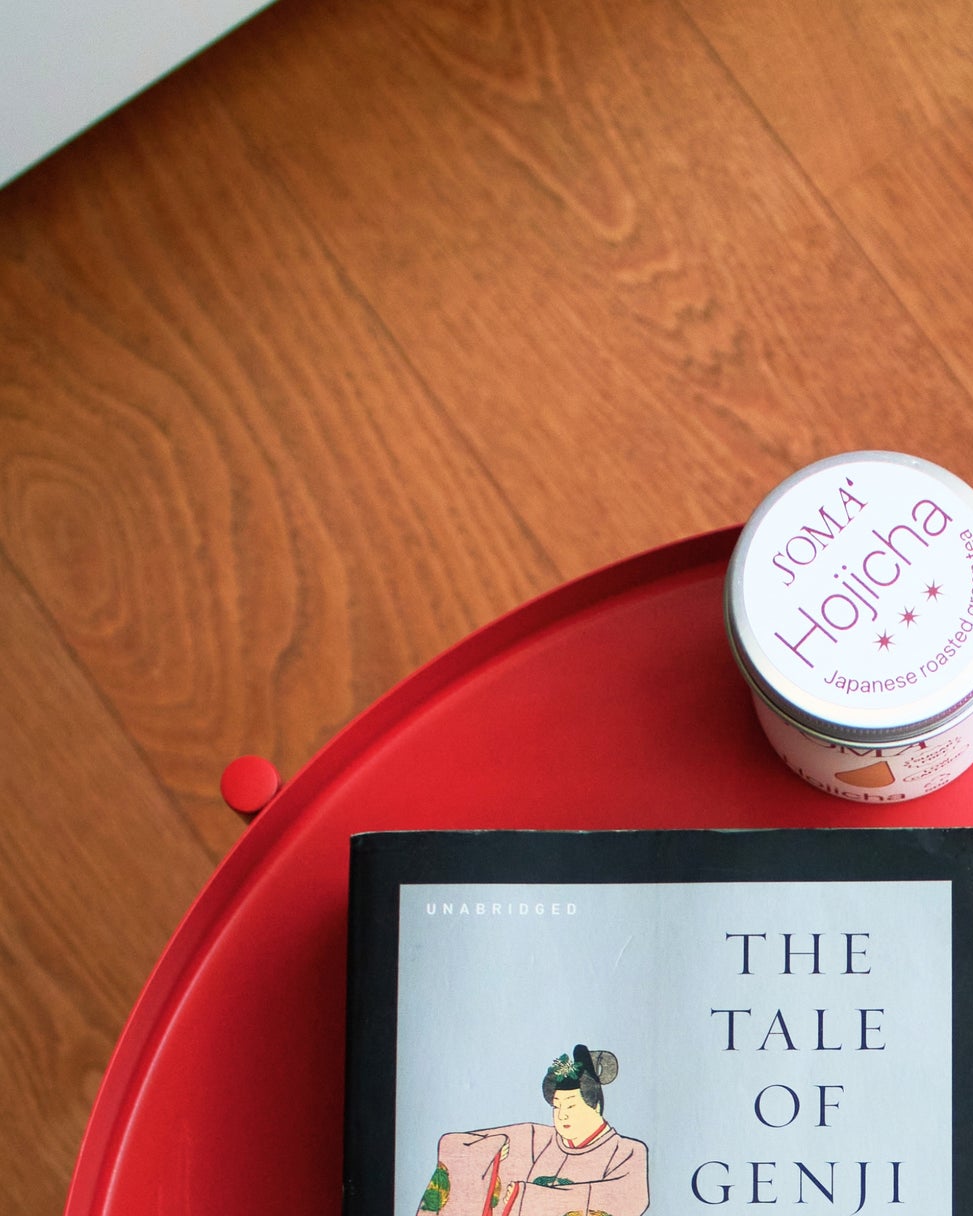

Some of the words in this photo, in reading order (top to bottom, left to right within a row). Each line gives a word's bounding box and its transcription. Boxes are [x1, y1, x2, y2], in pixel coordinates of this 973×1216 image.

[774, 499, 953, 668] Hojicha
[823, 669, 918, 695] Japanese
[426, 902, 578, 916] UNABRIDGED
[724, 931, 873, 975] THE
[709, 1007, 887, 1052] TALE
[753, 1084, 846, 1129] OF
[690, 1160, 905, 1216] GENJI
